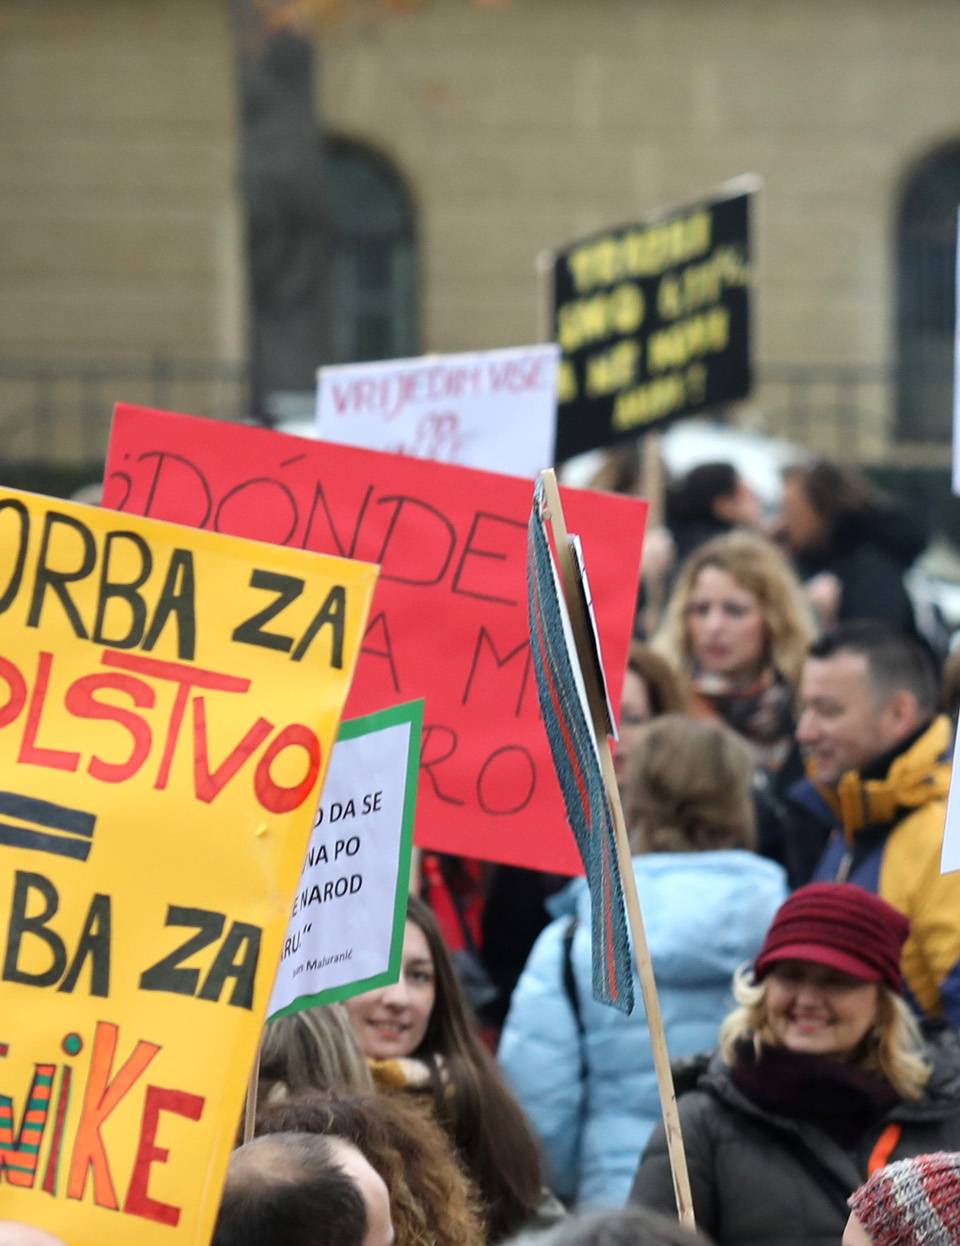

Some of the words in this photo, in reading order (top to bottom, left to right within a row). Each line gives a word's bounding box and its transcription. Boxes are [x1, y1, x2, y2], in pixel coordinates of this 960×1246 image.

[232, 568, 347, 669] ZA
[329, 799, 356, 824] DA
[361, 791, 383, 816] SE
[334, 836, 360, 861] PO
[300, 874, 363, 912] NAROD
[139, 906, 264, 1011] ZA
